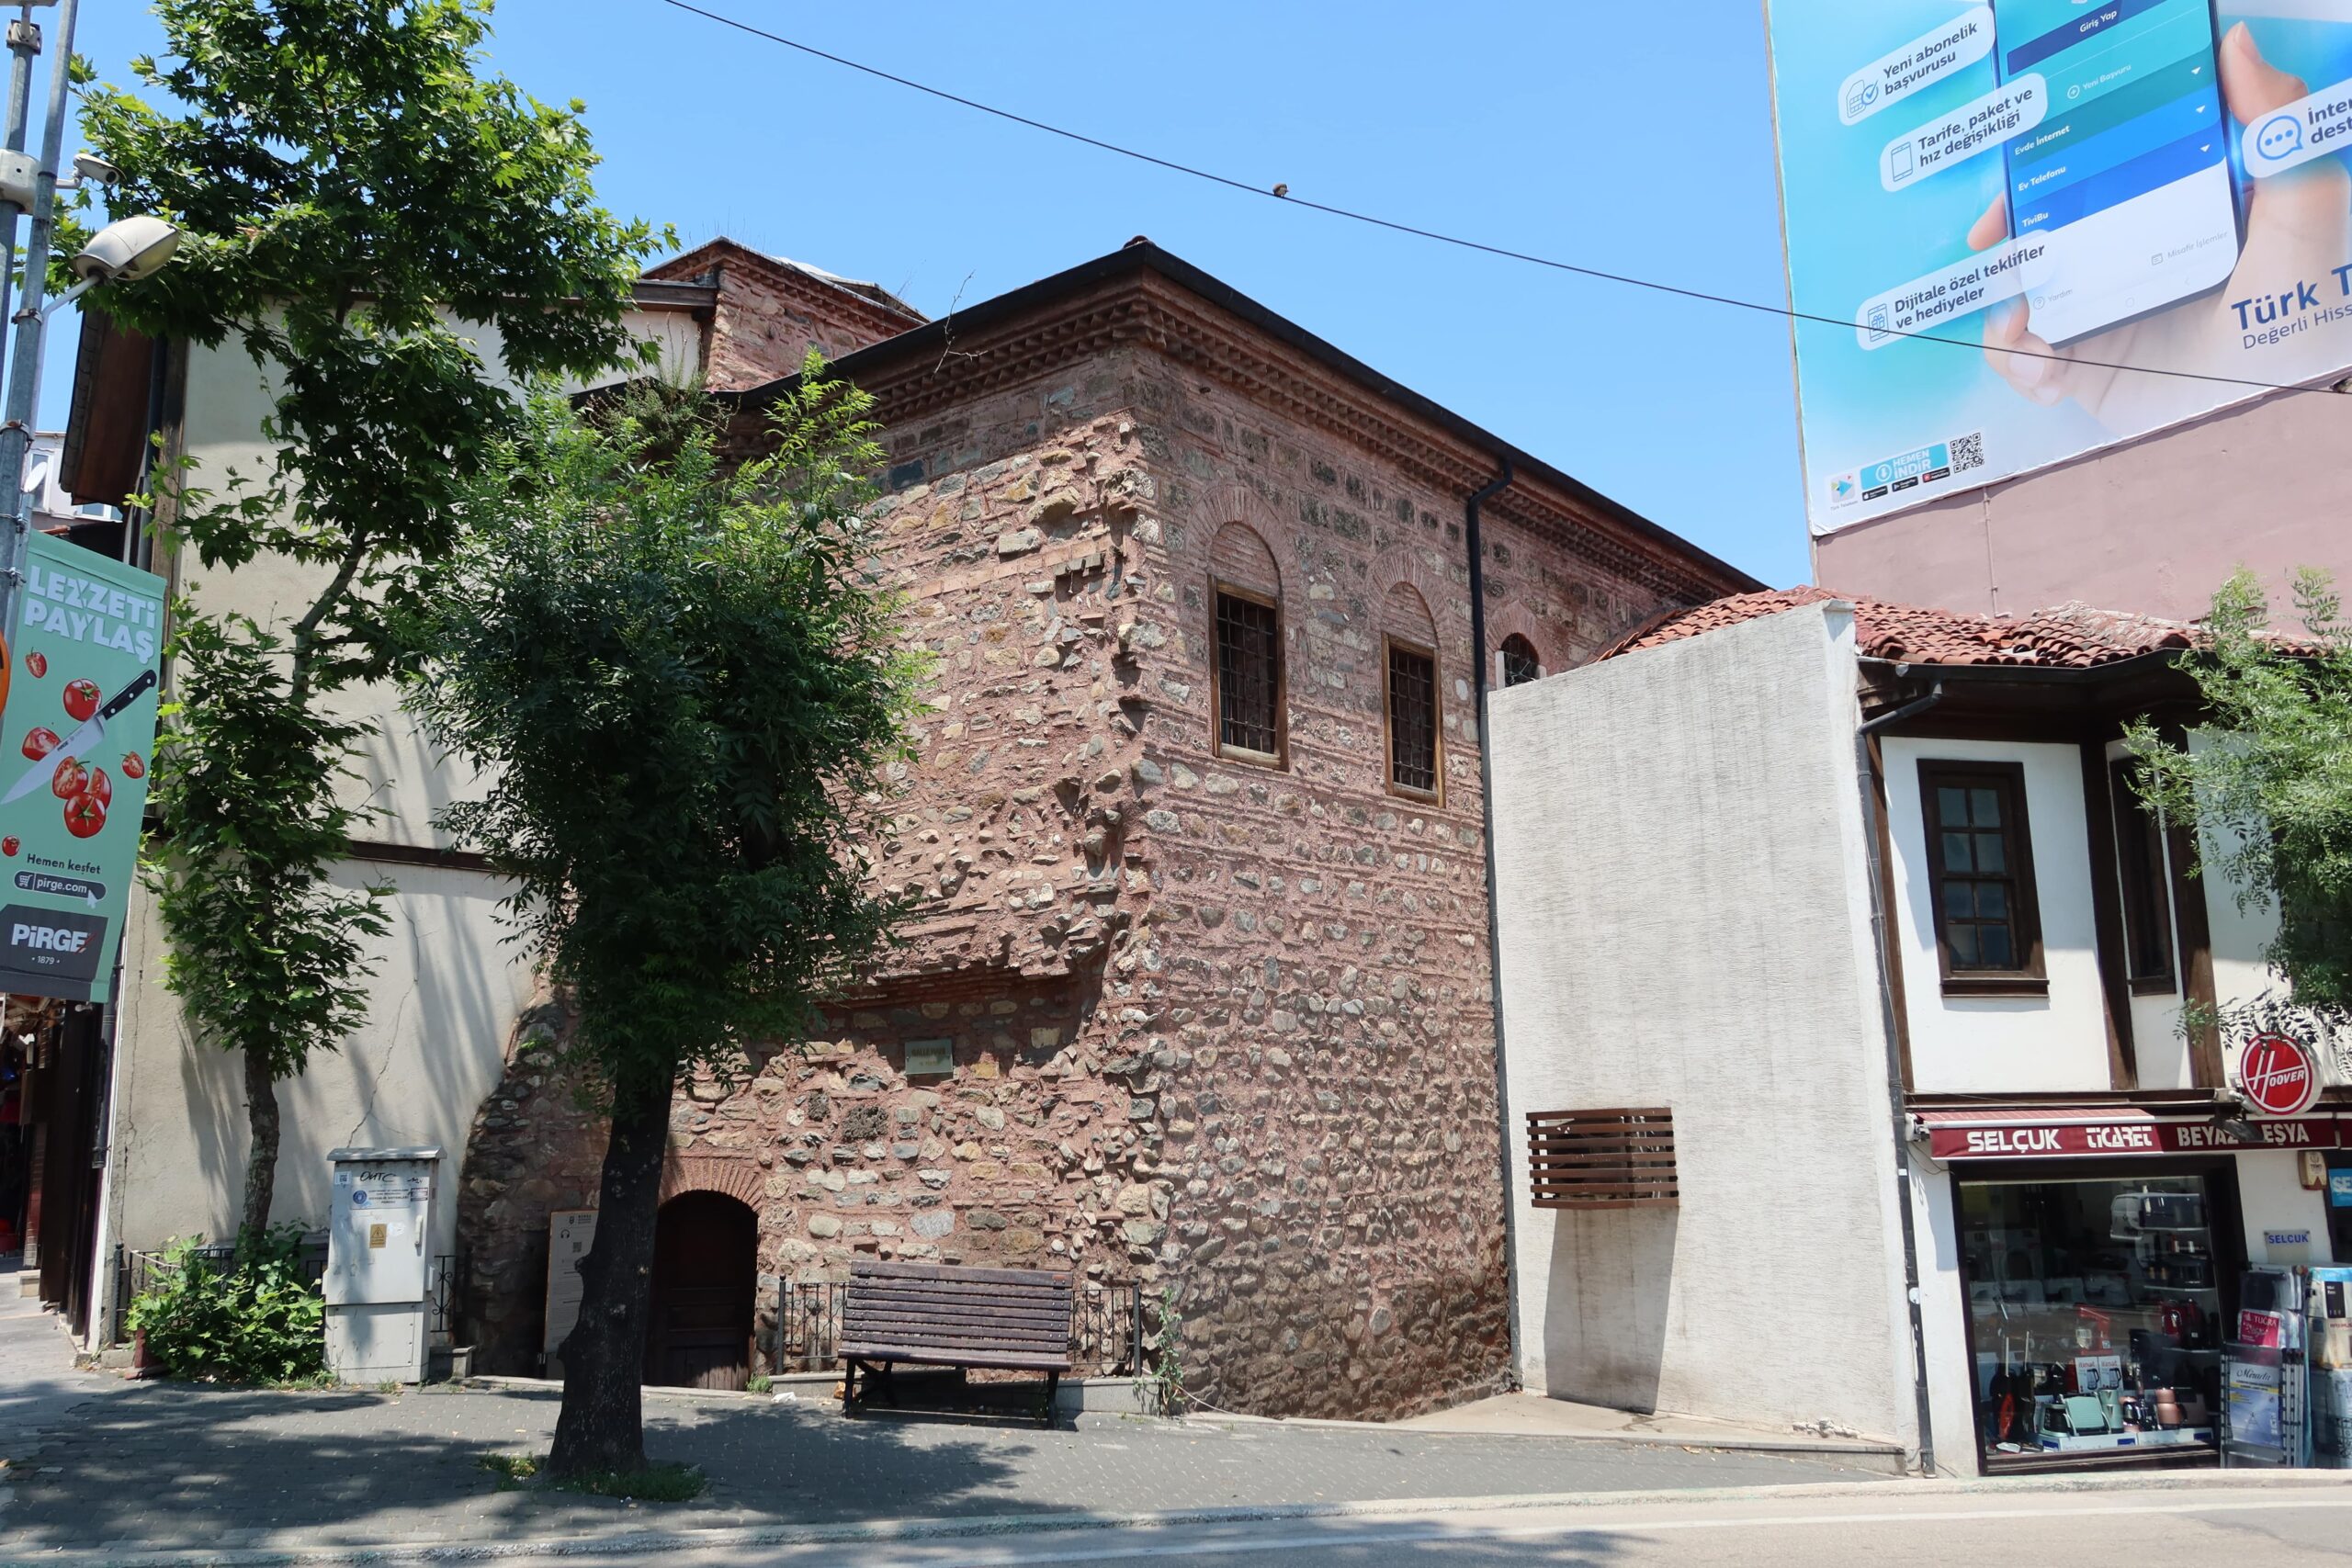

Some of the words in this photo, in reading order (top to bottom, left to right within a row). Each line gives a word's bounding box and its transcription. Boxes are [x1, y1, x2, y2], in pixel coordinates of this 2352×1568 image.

[2079, 18, 2099, 33] Giriş
[2100, 10, 2117, 22] Yap
[1883, 55, 1913, 79] Yeni
[1916, 22, 1978, 62] abonelik
[1884, 51, 1956, 96] başvurusu
[2082, 79, 2099, 90] Yeni
[2099, 64, 2132, 83] Başvuru
[1917, 122, 1965, 152] Tarife,
[1969, 97, 2011, 130] paket
[2014, 89, 2033, 106] ve
[1919, 149, 1941, 168] hız
[1944, 109, 2021, 154] değişikliği
[2014, 142, 2035, 155] Evde
[2036, 125, 2070, 147] İnternet
[2018, 182, 2029, 191] Ev
[2030, 166, 2066, 186] Telefonu
[1894, 285, 1946, 313] Dijitale
[1950, 269, 1981, 291] özel
[1984, 244, 2045, 278] teklifler
[1895, 315, 1913, 330] ve
[1916, 287, 1984, 322] hediyeler
[2231, 279, 2321, 331] Türk
[2243, 317, 2308, 349] Değerli
[1893, 448, 1929, 467] HEMEN
[24, 597, 154, 665] PAYLAŞ
[27, 853, 64, 869] Hemen
[67, 859, 101, 874] keşfet
[37, 877, 87, 894] pirge.com
[38, 955, 54, 964] 1879
[2247, 1050, 2305, 1102] HOOVER
[1967, 1129, 2062, 1154] SELÇUK
[2261, 1123, 2310, 1145] EŞYA
